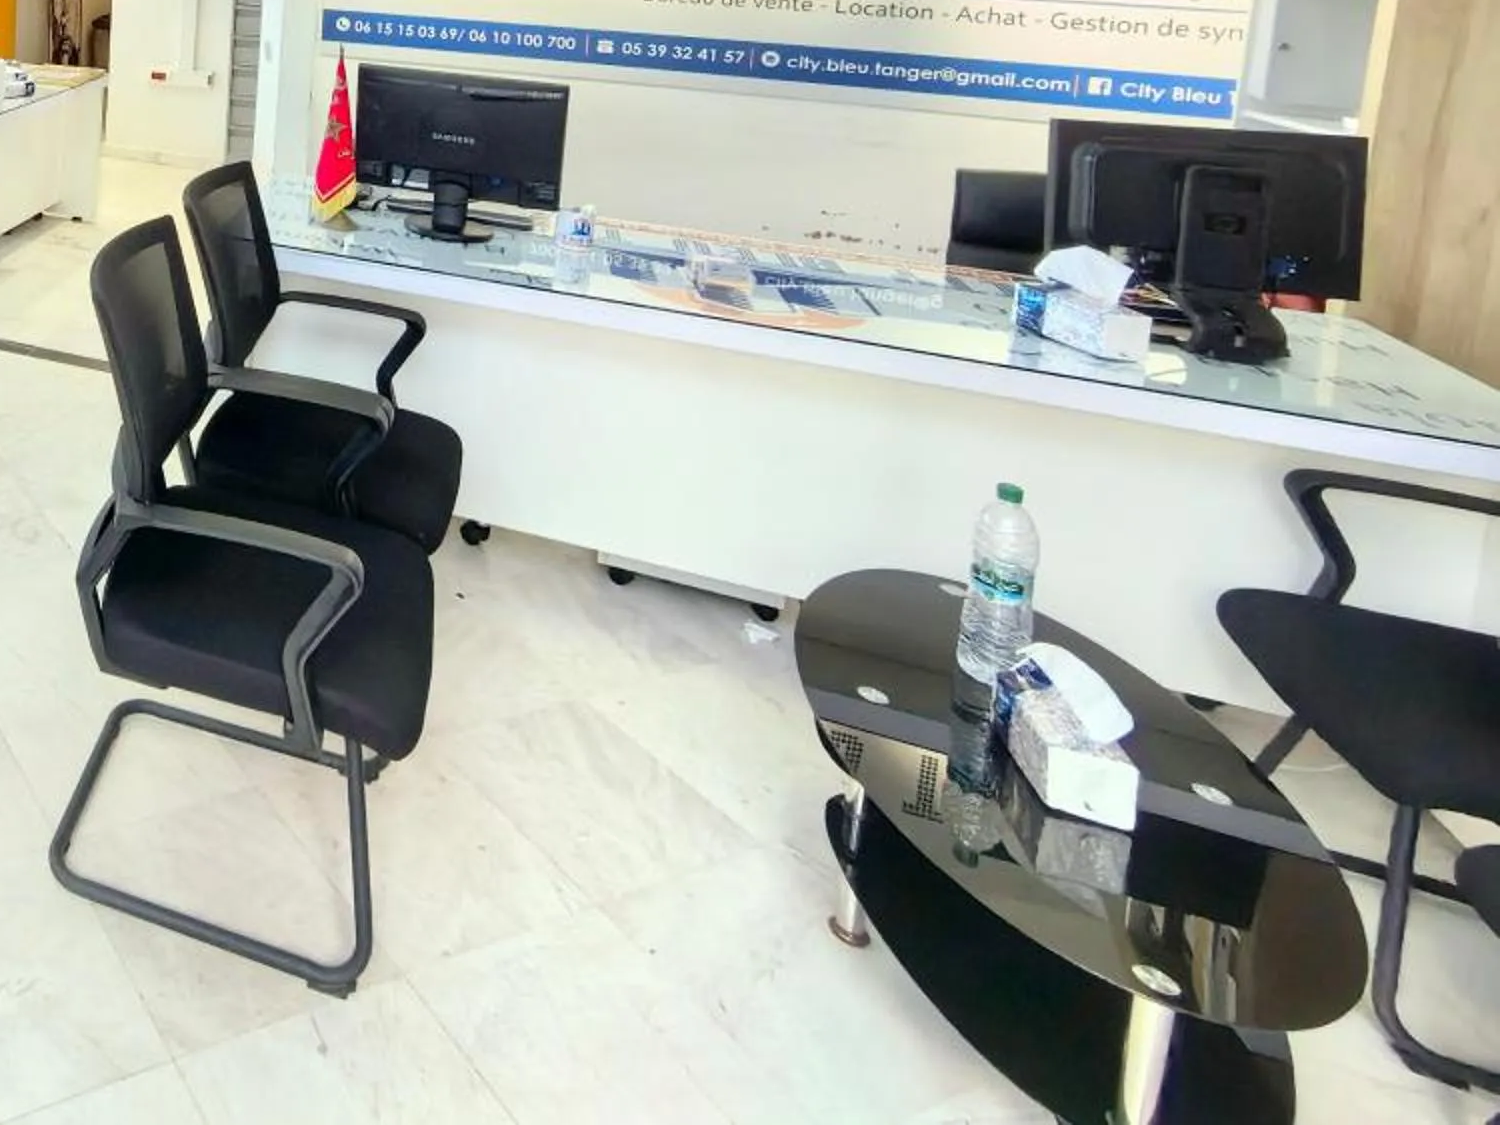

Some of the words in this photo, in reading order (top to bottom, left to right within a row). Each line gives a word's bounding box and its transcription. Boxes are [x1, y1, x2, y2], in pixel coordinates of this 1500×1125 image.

[354, 20, 371, 34] 06
[376, 21, 392, 35] 15
[398, 23, 414, 37] 15
[417, 25, 435, 39] 03
[469, 28, 487, 43] 06
[493, 30, 510, 45] 10
[515, 31, 543, 48] 100
[547, 34, 576, 50] 700
[956, 5, 1027, 27] Achat
[1050, 11, 1149, 36] Gestion
[1157, 18, 1190, 38] de
[621, 42, 641, 56] 05
[647, 43, 667, 58] 39
[672, 45, 693, 60] 32
[697, 47, 717, 63] 41
[723, 50, 745, 65] 57
[786, 55, 1071, 93] city.bleu.tanger@gmail.com
[1120, 81, 1165, 104] City
[1172, 86, 1221, 105] Bleu
